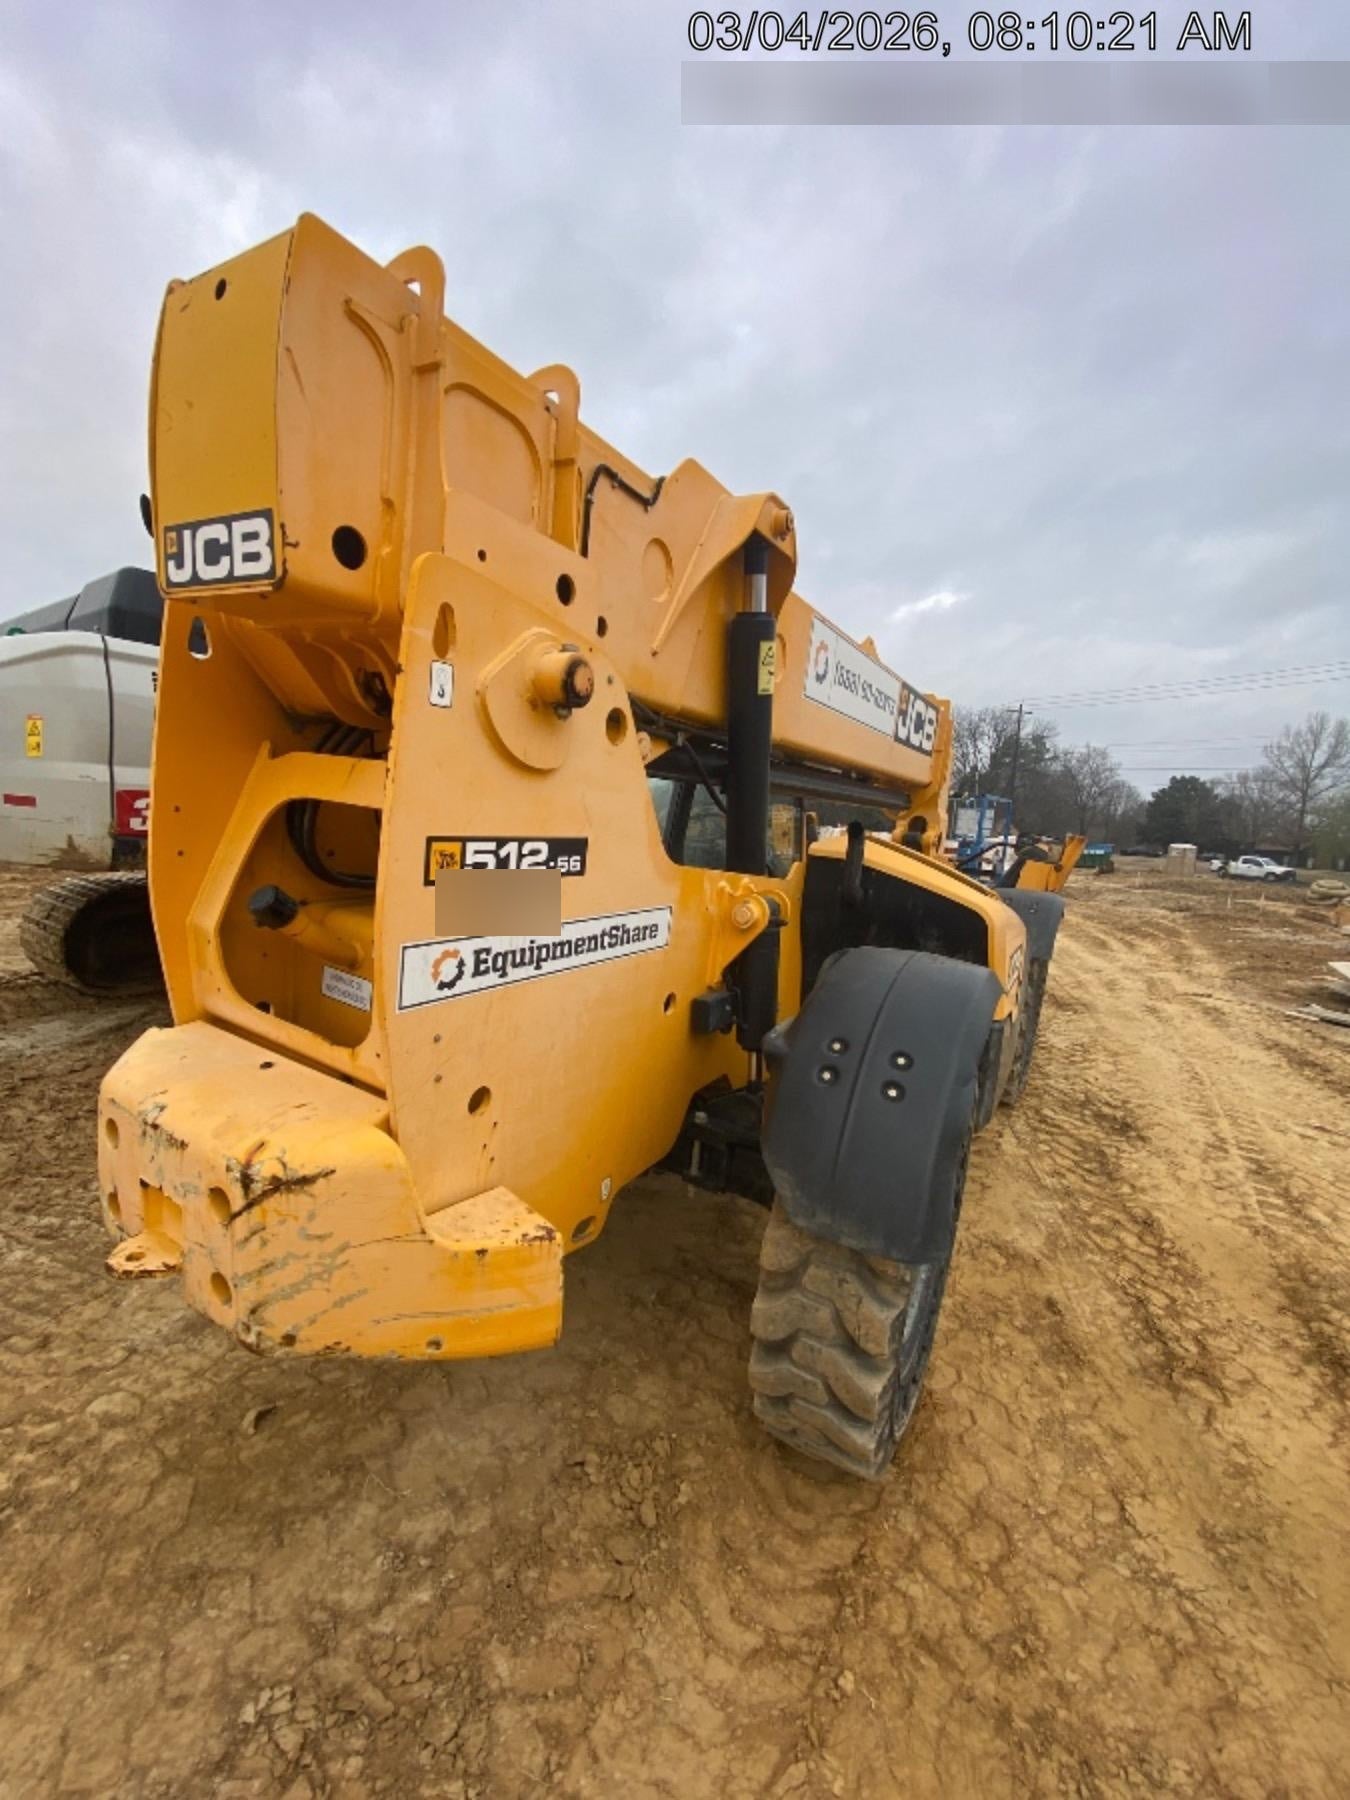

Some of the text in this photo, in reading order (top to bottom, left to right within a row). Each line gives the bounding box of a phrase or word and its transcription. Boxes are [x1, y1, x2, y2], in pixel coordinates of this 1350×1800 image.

[167, 517, 272, 583] JCB
[898, 692, 937, 751] JCB
[471, 923, 659, 978] EquipmentShare
